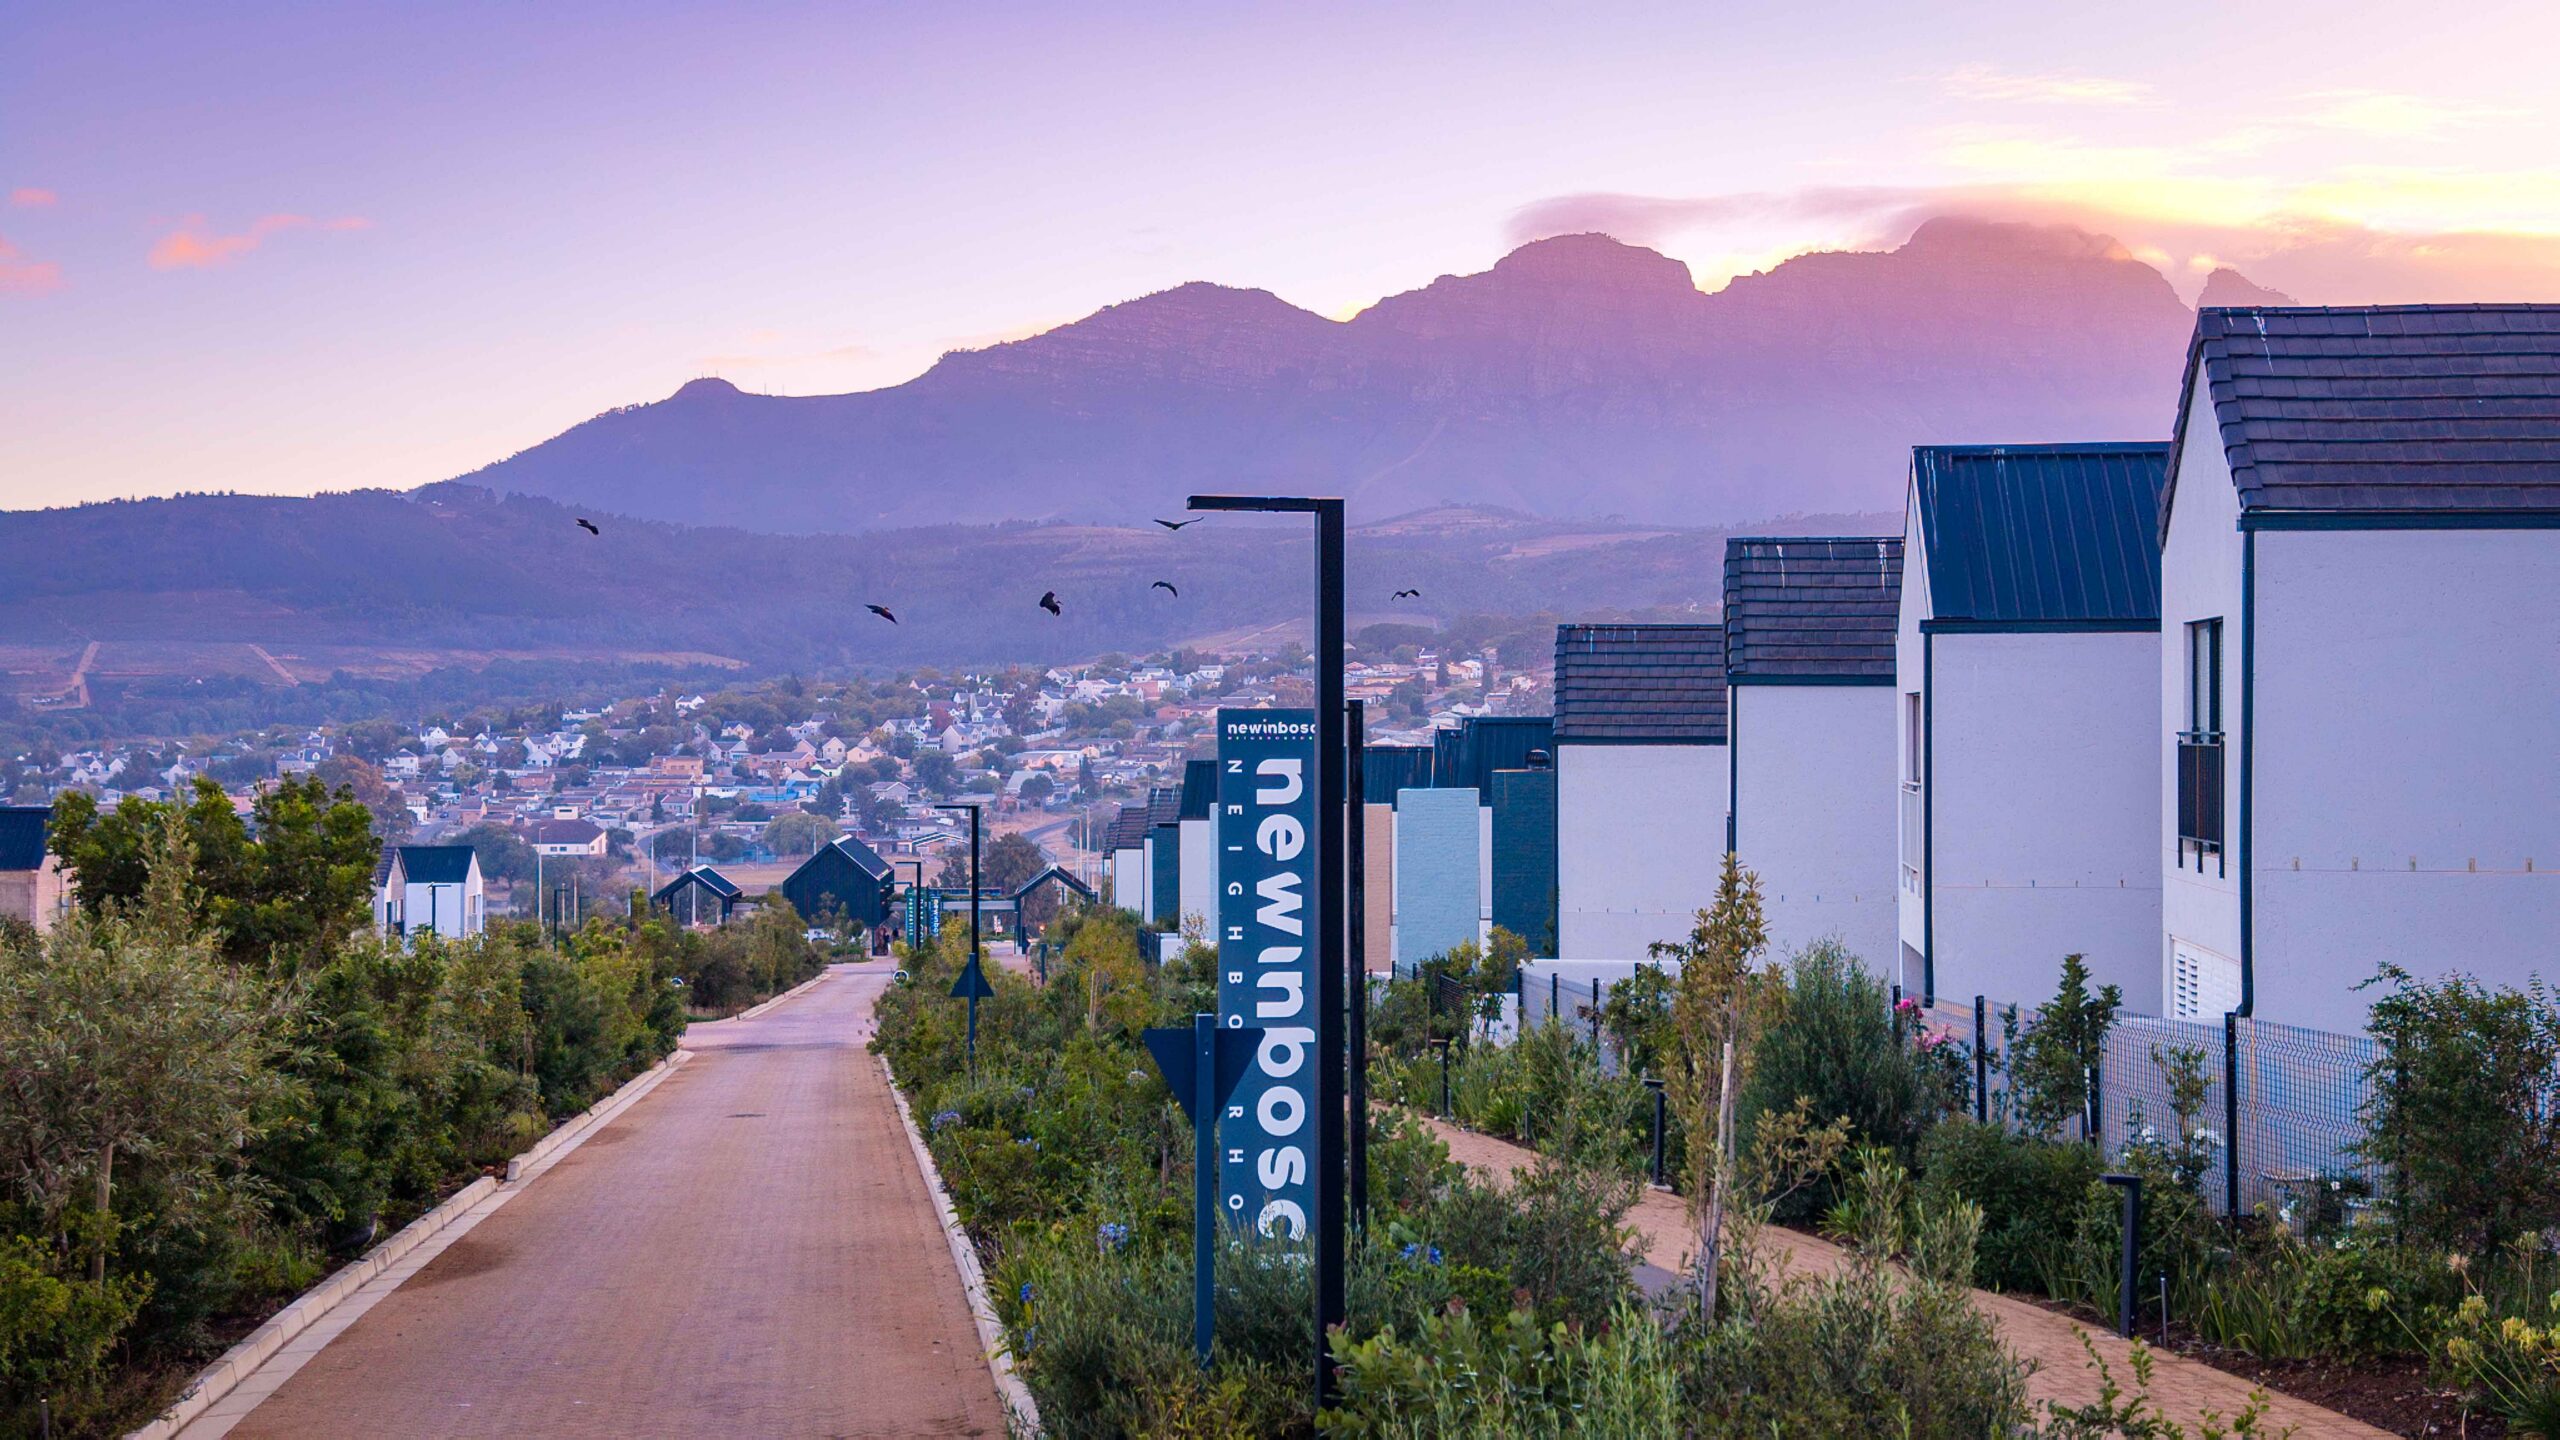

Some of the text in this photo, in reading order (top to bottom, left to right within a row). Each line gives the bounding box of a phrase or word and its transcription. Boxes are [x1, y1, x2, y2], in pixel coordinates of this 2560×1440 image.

[1227, 718, 1315, 734] newinbosc
[1227, 759, 1244, 1253] NEIGHBORHO
[1256, 758, 1315, 1275] newinbosc
